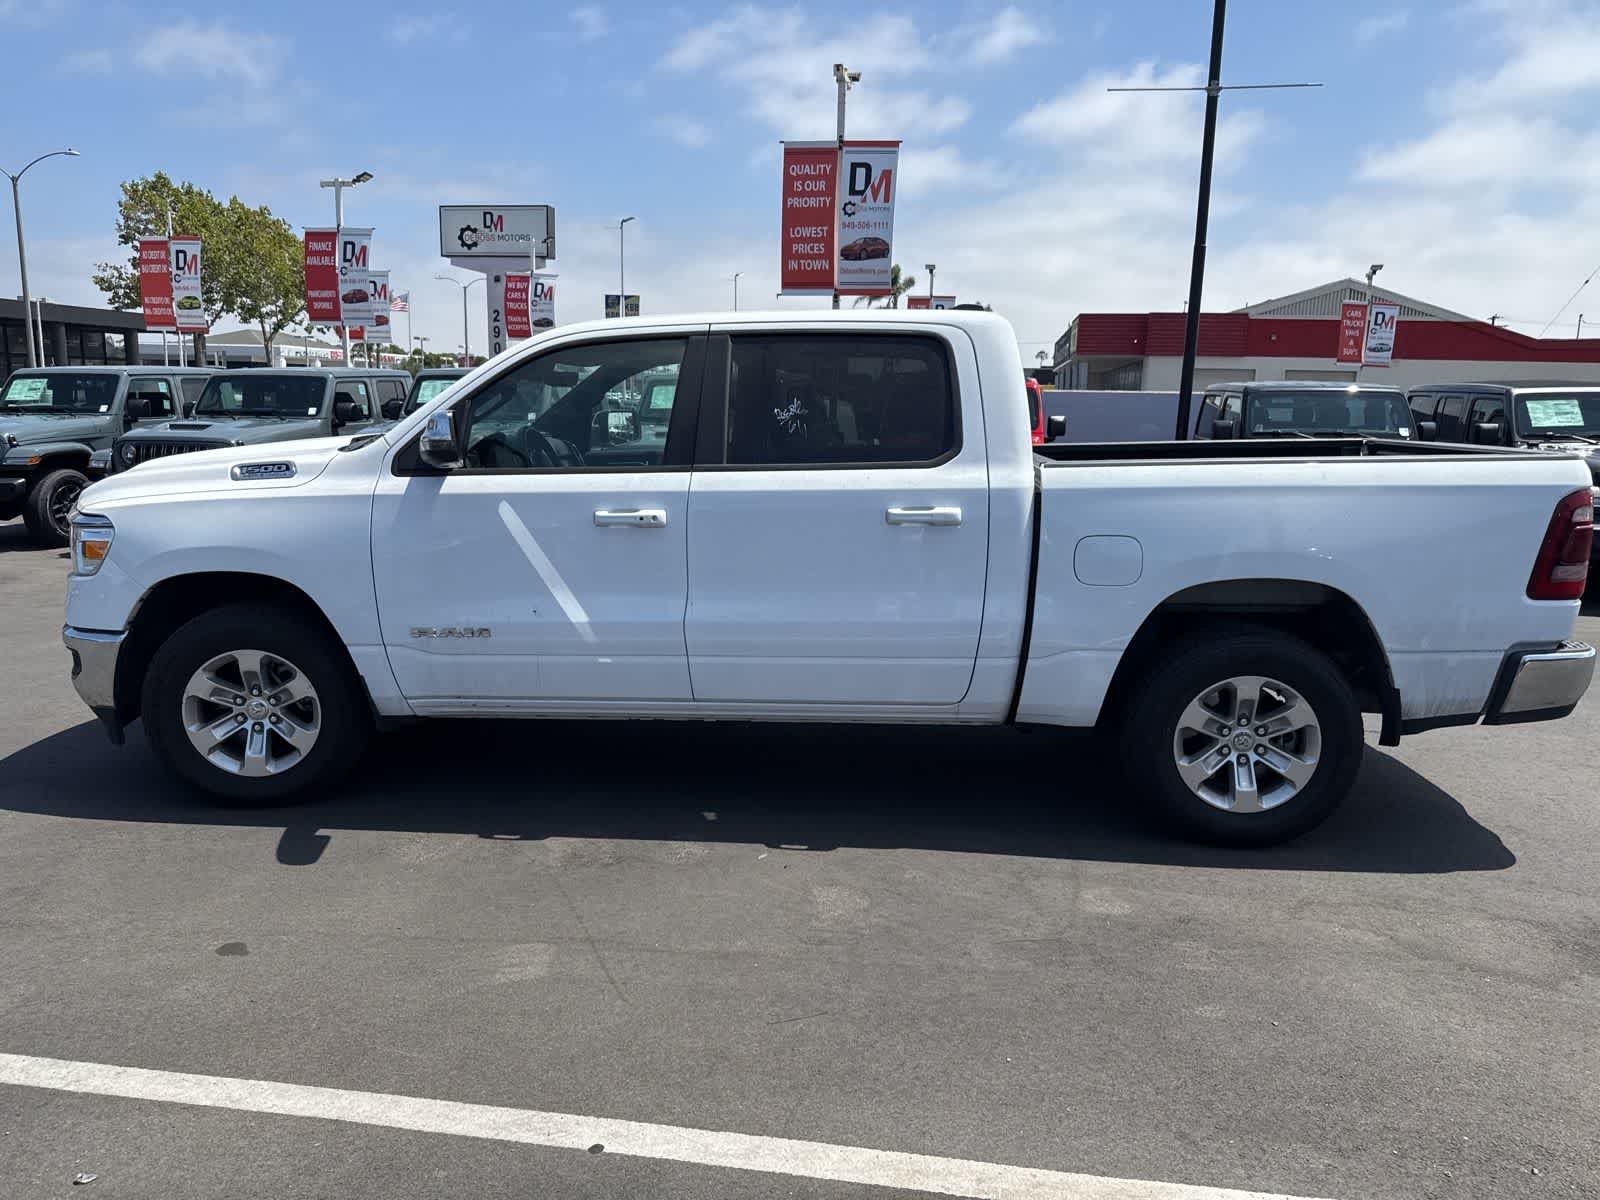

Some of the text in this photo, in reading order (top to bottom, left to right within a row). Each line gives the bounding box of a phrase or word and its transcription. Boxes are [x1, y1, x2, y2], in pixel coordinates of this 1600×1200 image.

[789, 164, 832, 176] QUALITY
[793, 180, 826, 192] IS OUR
[787, 197, 832, 208] PRIORITY
[497, 233, 531, 242] MOTORS
[790, 226, 828, 238] LOWEST
[308, 241, 332, 251] FINANCE
[792, 243, 825, 254] PRICES
[306, 255, 335, 266] AVAILABLE
[788, 259, 829, 271] IN TOWN
[507, 291, 520, 299] CARS
[506, 302, 528, 310] TRUCKS
[1346, 310, 1361, 318] CARS
[1343, 319, 1364, 327] TRUCKS
